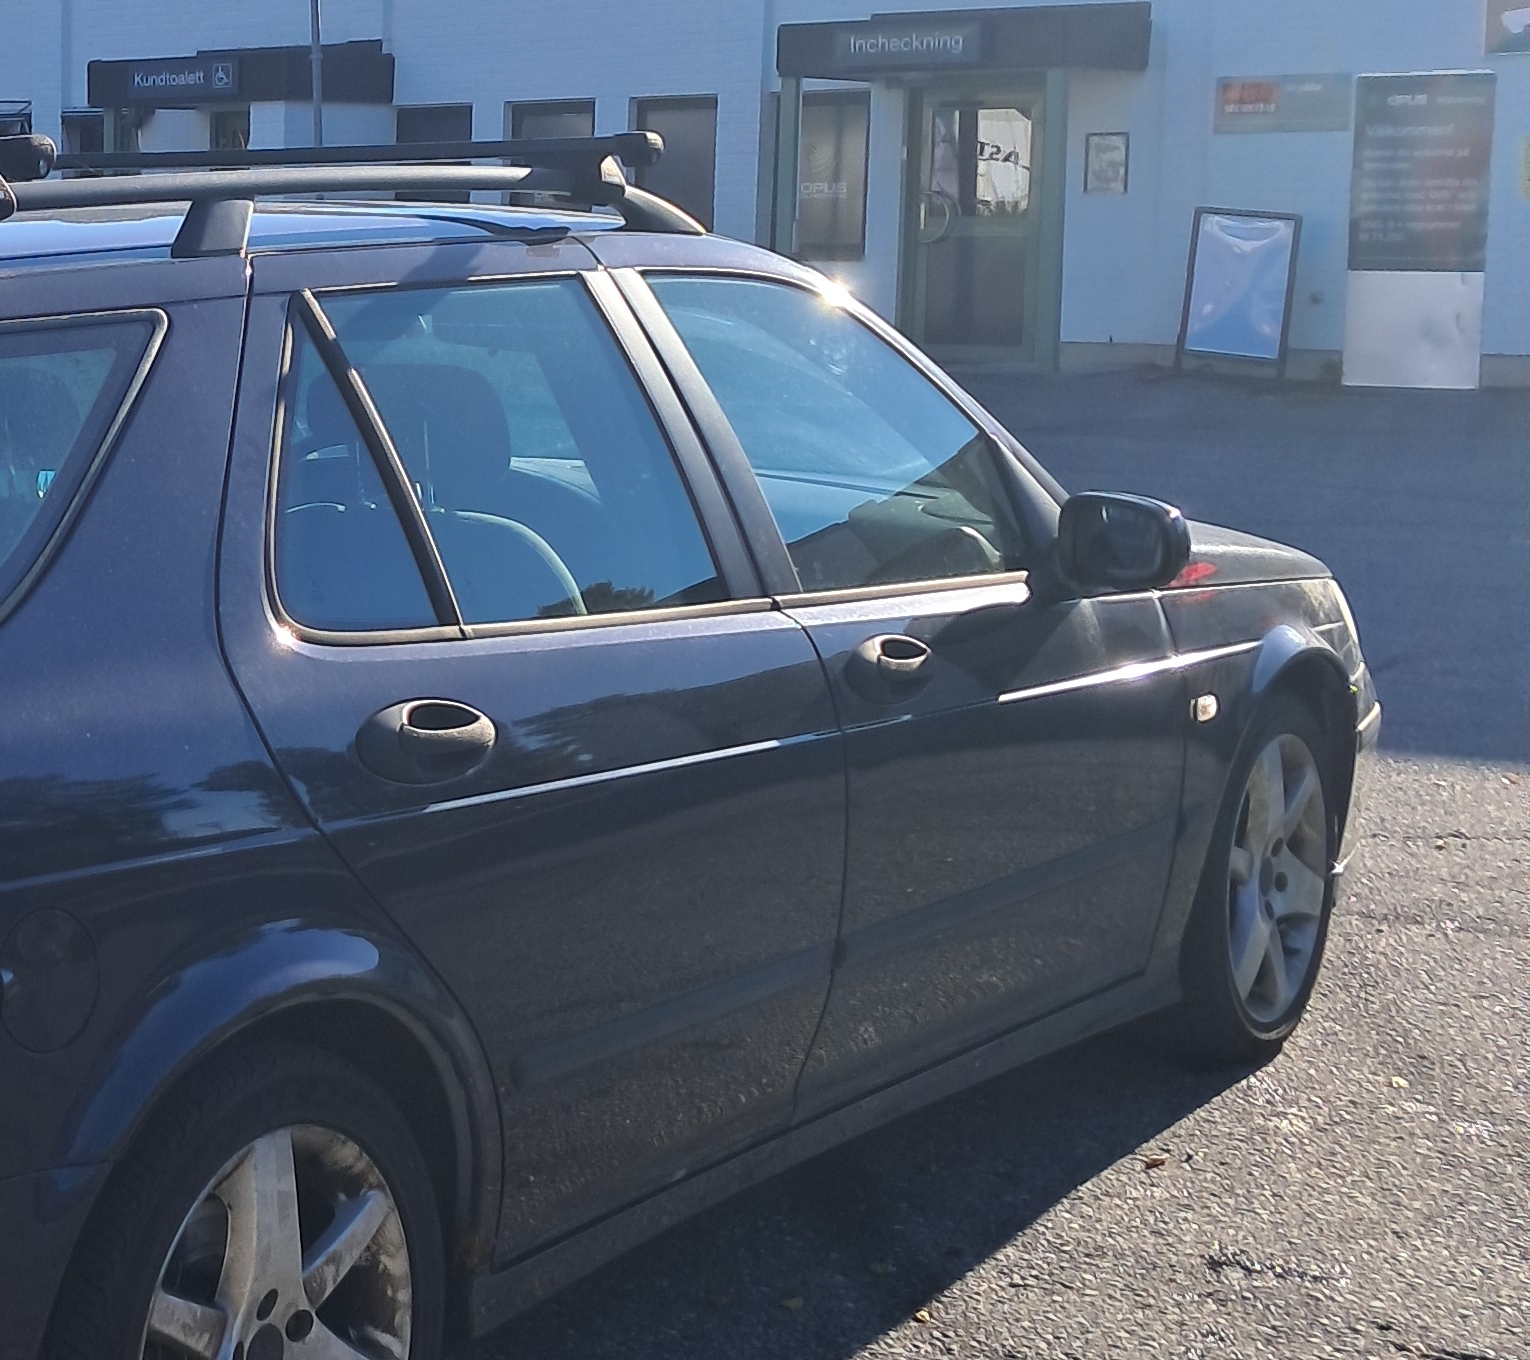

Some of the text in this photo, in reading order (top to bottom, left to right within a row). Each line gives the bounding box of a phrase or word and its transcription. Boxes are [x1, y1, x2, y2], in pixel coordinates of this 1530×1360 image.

[849, 32, 964, 54] Incheckning
[133, 70, 205, 87] Kundtoalett
[800, 182, 848, 193] OPUS
